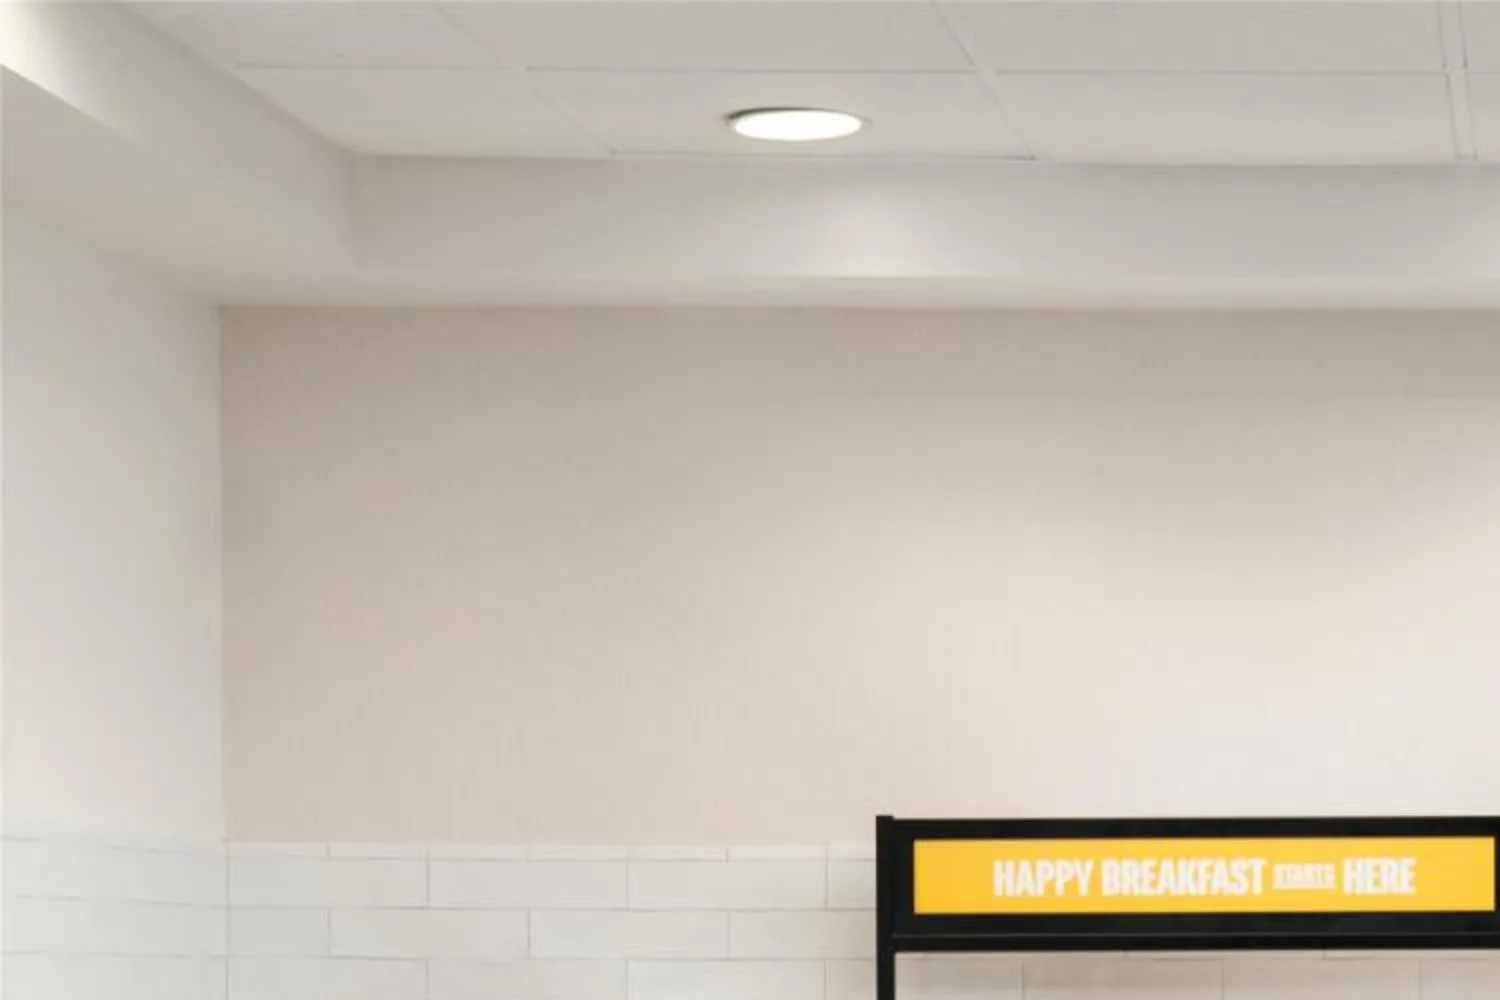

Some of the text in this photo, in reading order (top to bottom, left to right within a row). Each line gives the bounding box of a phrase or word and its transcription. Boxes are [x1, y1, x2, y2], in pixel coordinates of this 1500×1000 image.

[993, 860, 1093, 896] HAPPY
[1100, 859, 1266, 896] BREAKFAST
[1343, 858, 1417, 895] HERE
